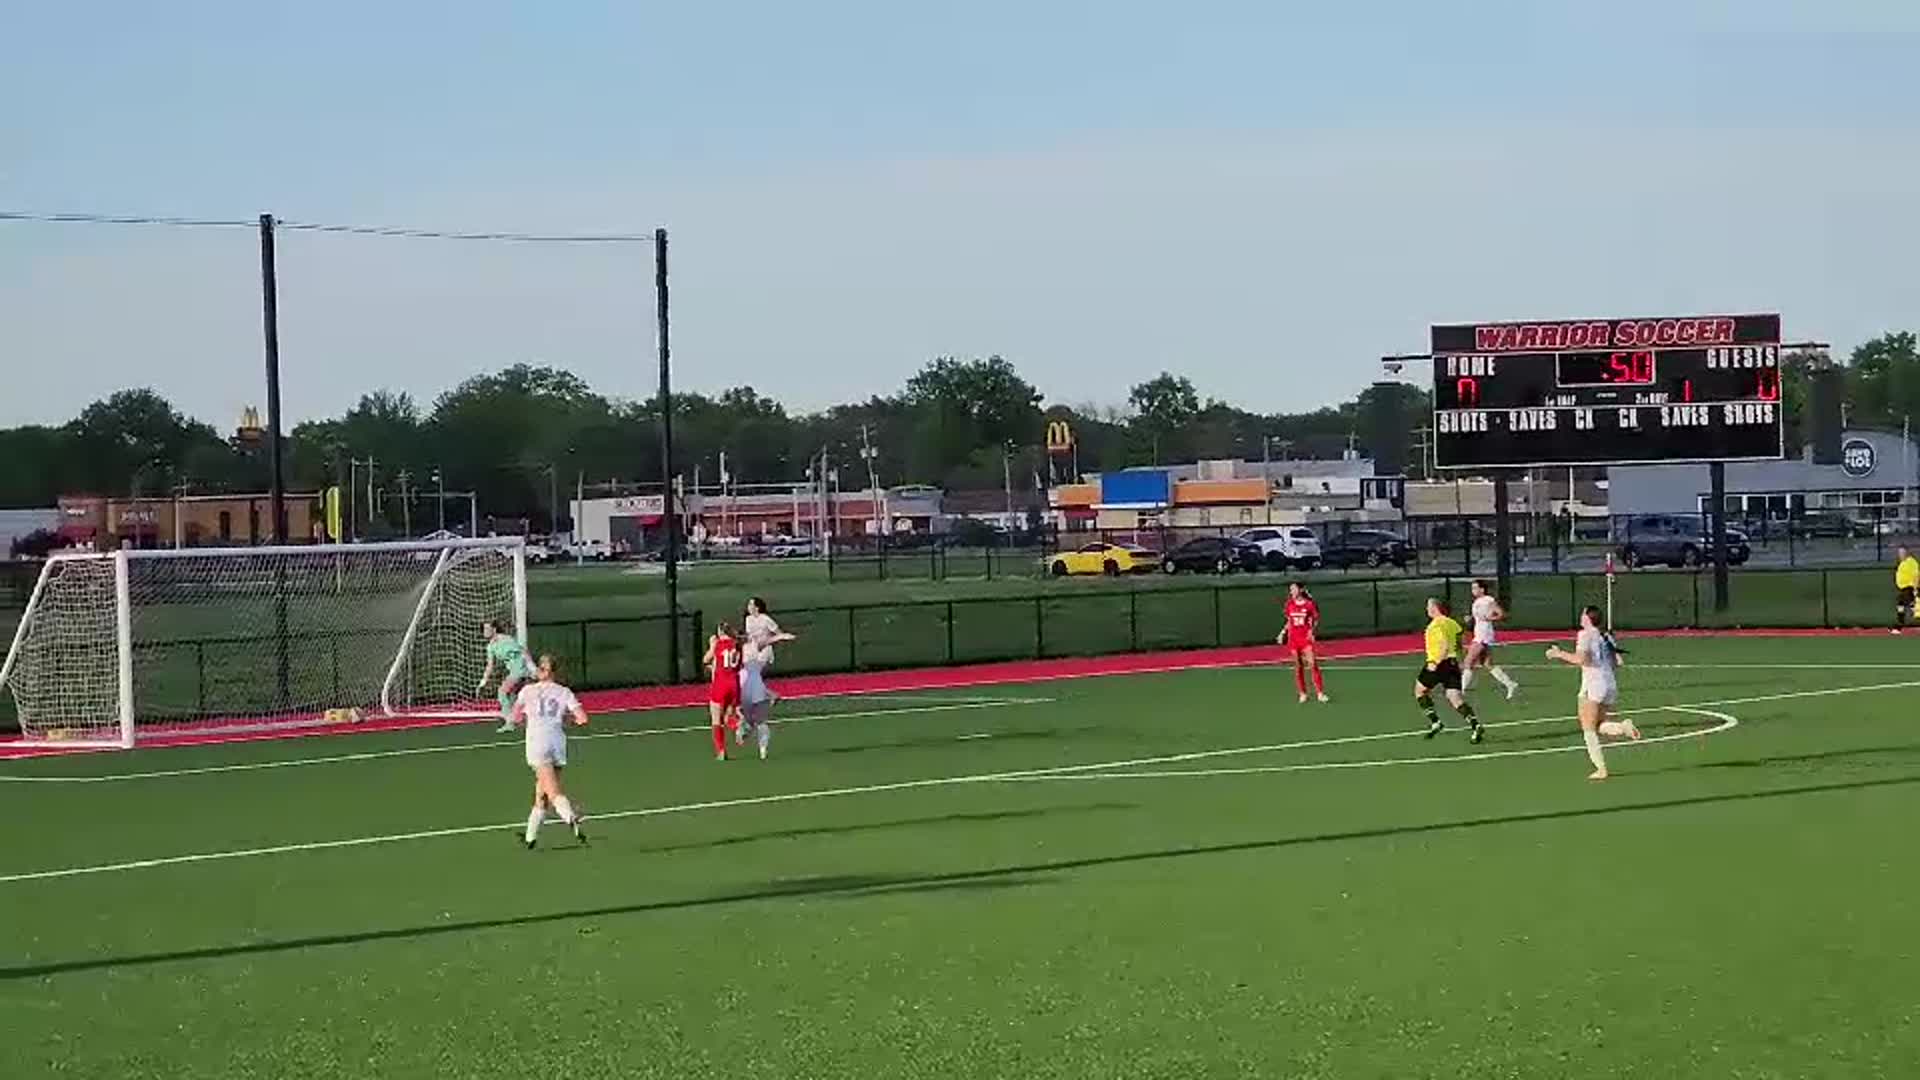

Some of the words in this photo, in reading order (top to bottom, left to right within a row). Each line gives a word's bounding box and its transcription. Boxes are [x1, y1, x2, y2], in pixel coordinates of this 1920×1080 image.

[1476, 322, 1611, 350] WARRIOR
[1614, 319, 1735, 346] SOCCER
[1447, 357, 1497, 376] HOME
[1707, 347, 1777, 368] GUESTS
[1440, 413, 1488, 432] SHOTS
[1508, 410, 1557, 431] SAVES
[1661, 406, 1709, 426] SAVES
[1724, 404, 1774, 425] SHOTS
[720, 648, 740, 668] 10
